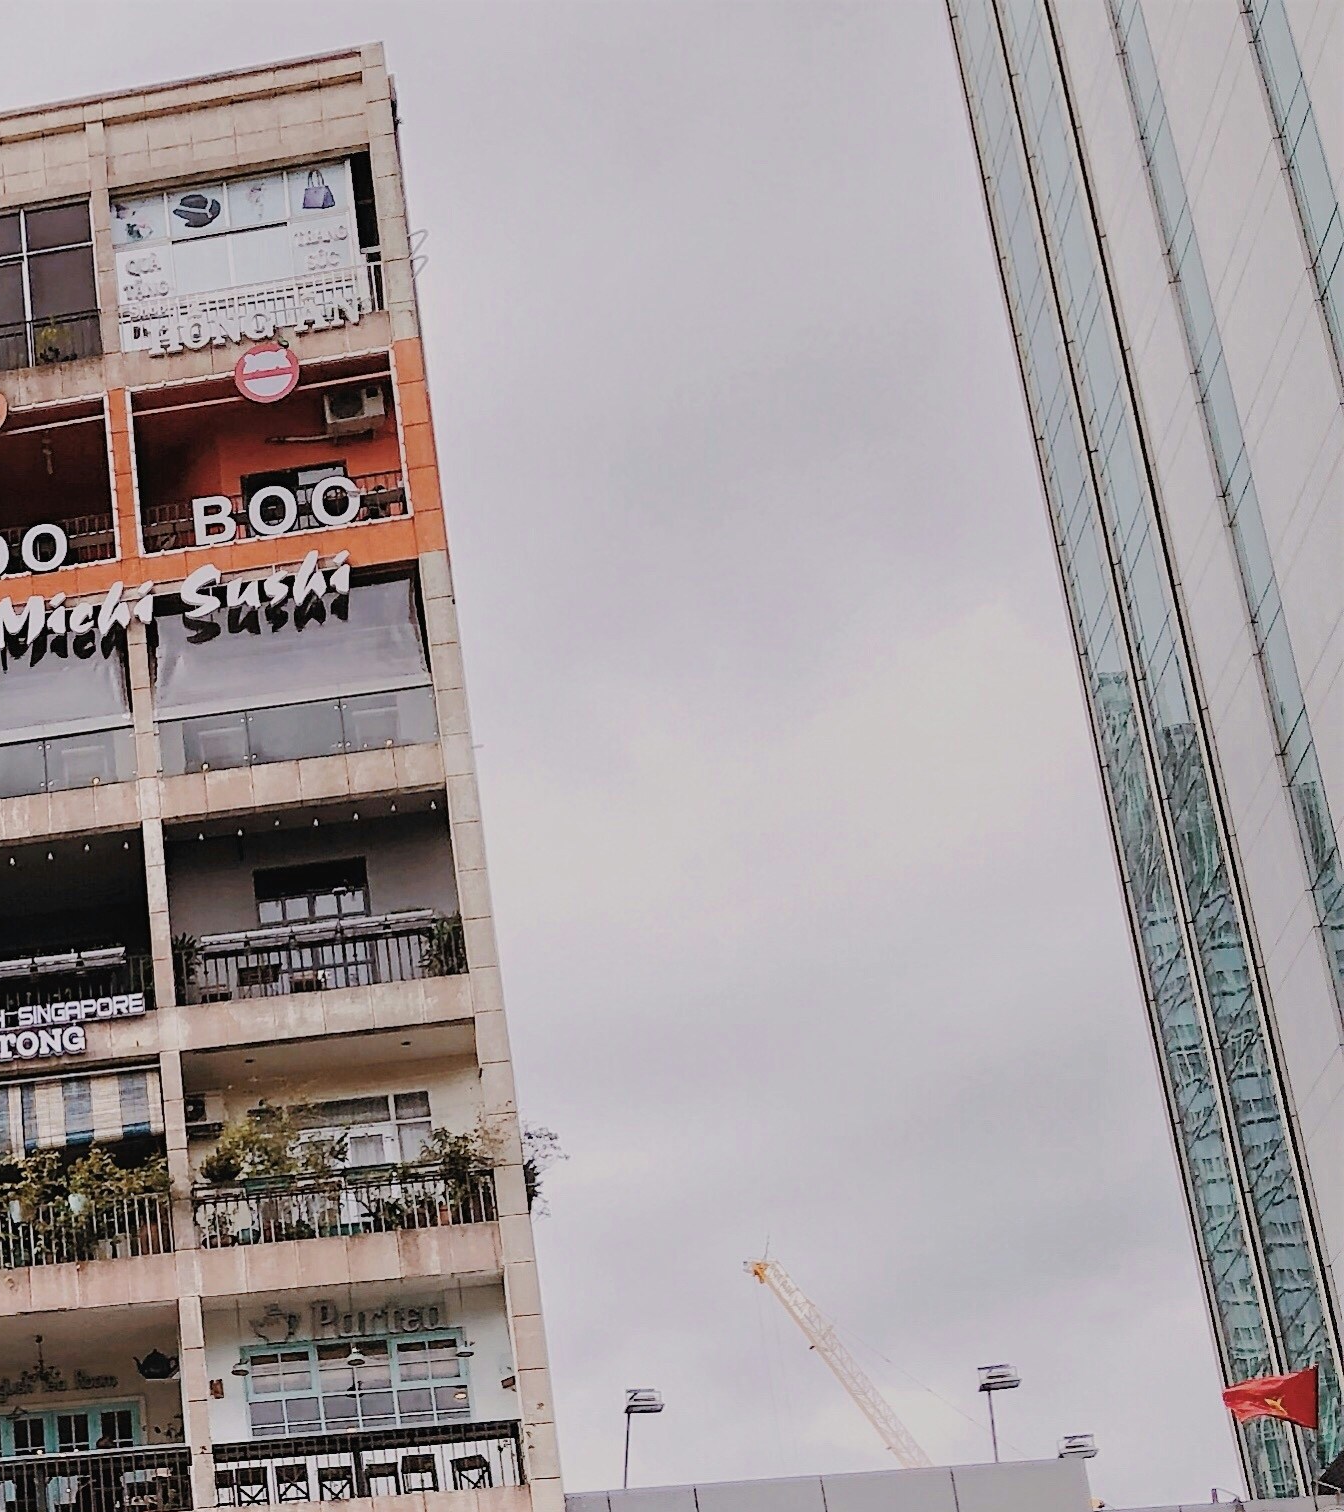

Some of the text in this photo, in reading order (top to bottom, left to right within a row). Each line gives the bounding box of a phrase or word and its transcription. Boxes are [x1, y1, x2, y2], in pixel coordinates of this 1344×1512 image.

[193, 476, 361, 546] BOO
[181, 550, 351, 619] Sushi
[18, 993, 144, 1026] SINGAPORE
[315, 1300, 440, 1338] Partea
